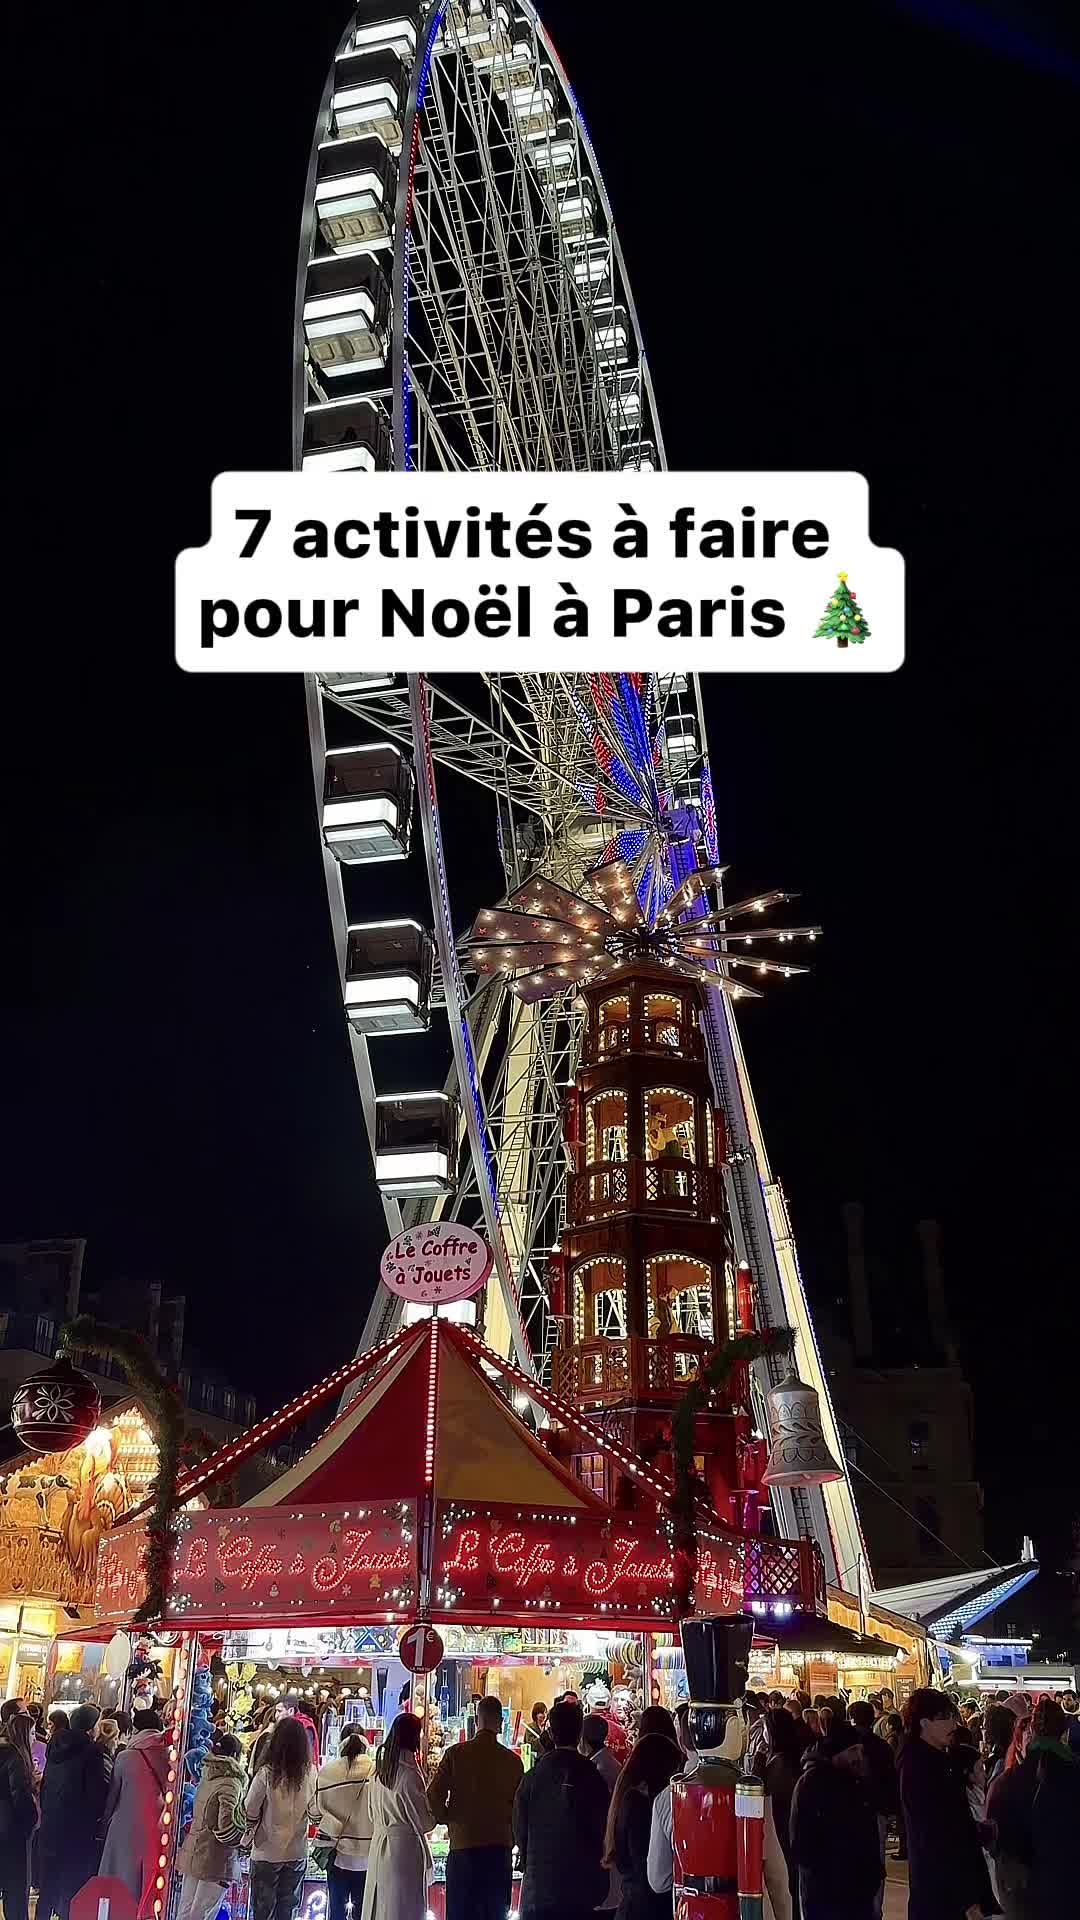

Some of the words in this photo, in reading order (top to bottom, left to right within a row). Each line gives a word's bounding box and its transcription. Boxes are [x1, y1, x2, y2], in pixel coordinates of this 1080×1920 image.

[395, 1242, 416, 1259] Le
[421, 1235, 478, 1256] Coffre
[395, 1266, 406, 1285] à
[412, 1265, 471, 1284] Jouets
